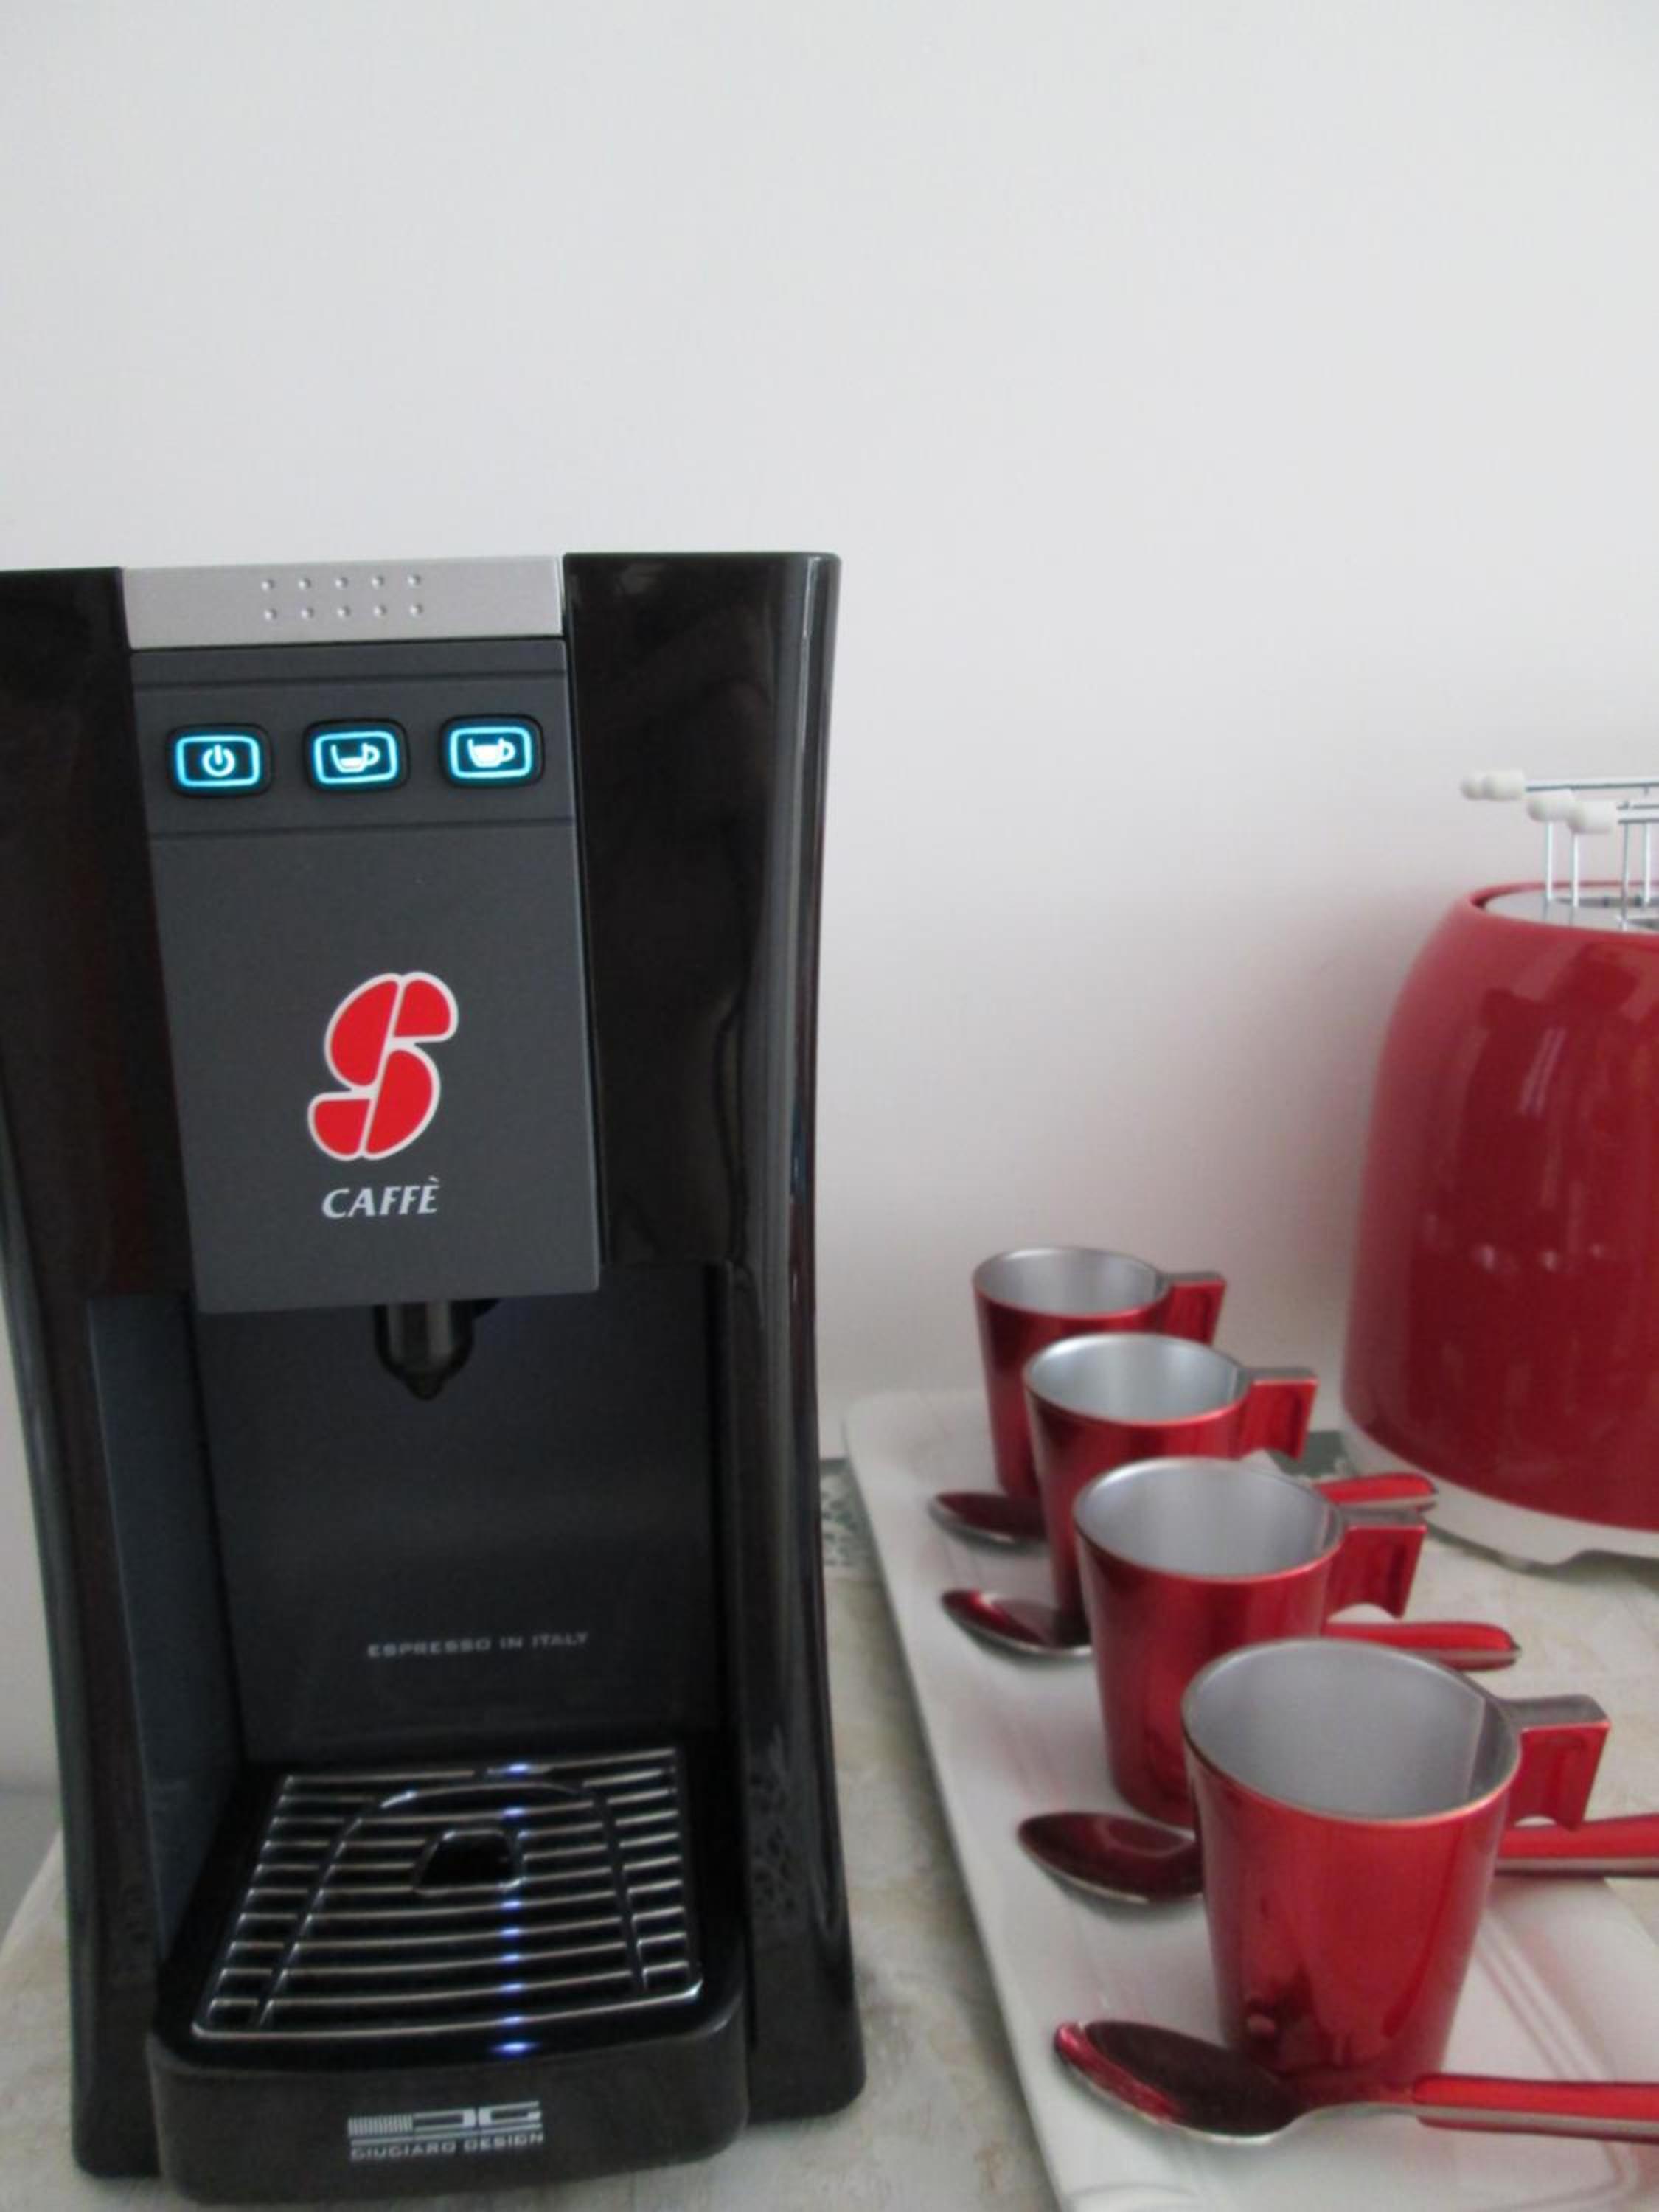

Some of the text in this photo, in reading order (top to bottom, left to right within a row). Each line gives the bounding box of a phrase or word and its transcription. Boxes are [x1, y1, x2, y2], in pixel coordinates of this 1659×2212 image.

[322, 1175, 440, 1220] CAFFÈ
[367, 1630, 588, 1658] ESPRESSO IN ITALY
[464, 2132, 543, 2152] DESIGN
